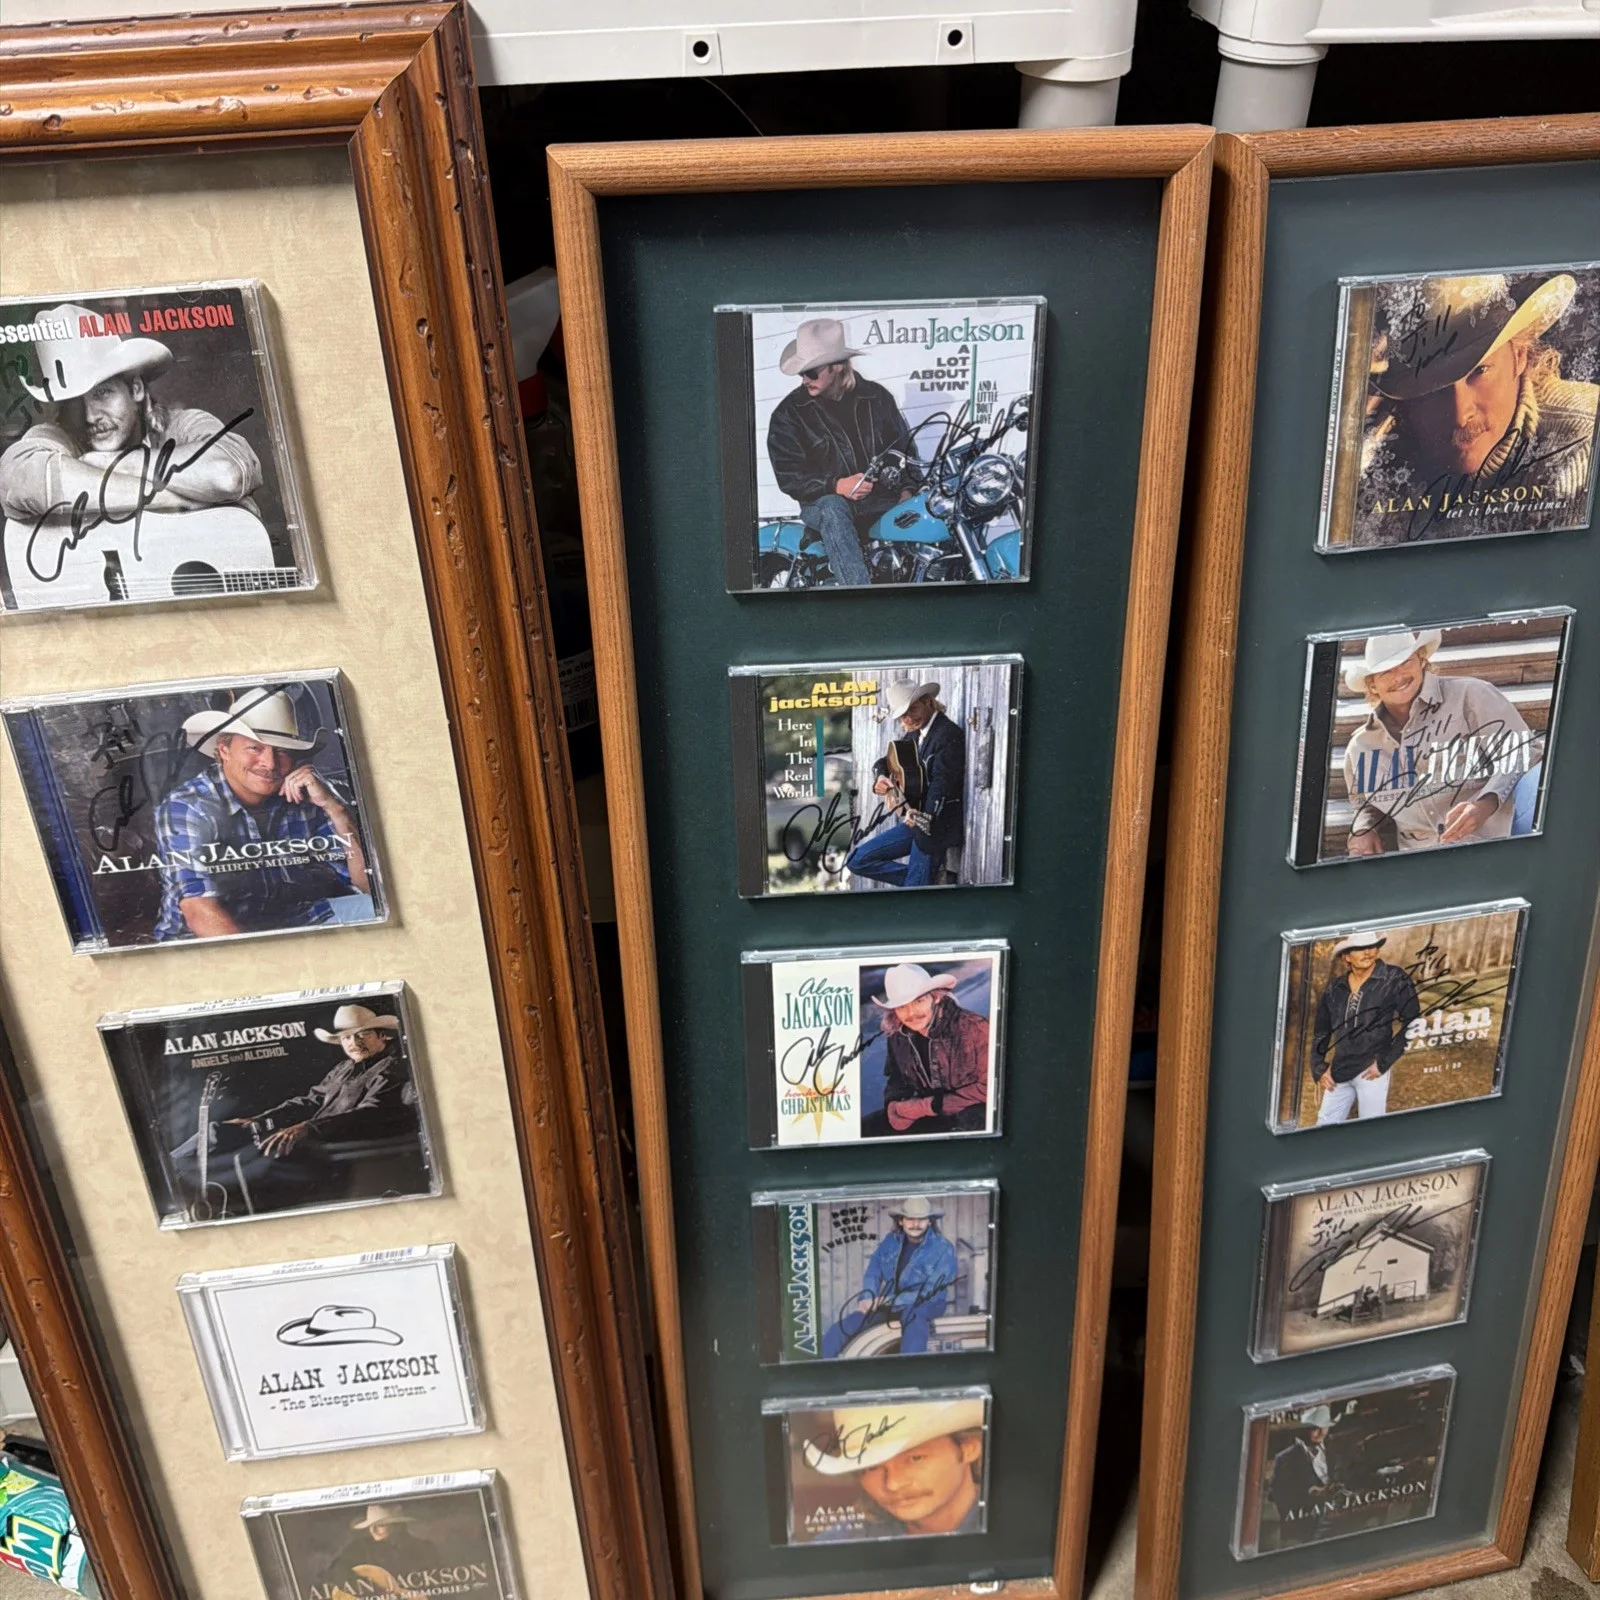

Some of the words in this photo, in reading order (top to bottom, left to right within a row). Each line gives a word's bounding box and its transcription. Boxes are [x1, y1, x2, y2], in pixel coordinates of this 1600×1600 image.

[0, 317, 73, 344] ssential
[78, 312, 132, 338] ALAN
[138, 303, 234, 333] JACKSON
[957, 344, 970, 354] A
[937, 356, 970, 366] LOT
[909, 369, 970, 380] ABOUT
[920, 381, 969, 392] LIVIN'
[977, 391, 998, 402] LITTLE
[1370, 495, 1431, 514] ALAN
[1439, 485, 1545, 512] JACKSON
[1468, 507, 1479, 516] it
[1485, 503, 1499, 515] be
[1503, 499, 1568, 514] Christmas
[811, 680, 877, 694] ALAN
[769, 695, 877, 713] jackson
[778, 719, 813, 731] Here
[800, 735, 816, 747] In
[785, 751, 814, 764] The
[1349, 744, 1416, 797] ALAN
[1419, 729, 1538, 787] JACKSON
[784, 768, 814, 781] Real
[773, 784, 814, 798] World
[92, 850, 195, 875] ALAN
[199, 833, 354, 864] JACKSON
[205, 859, 264, 875] THIRTY
[265, 855, 311, 869] MILES
[314, 850, 356, 863] WEST
[799, 977, 854, 998] Alan
[781, 993, 855, 1030] JACKSON
[1405, 1007, 1492, 1039] alan
[163, 1032, 218, 1055] ALAN
[221, 1021, 307, 1047] JACKSON
[1404, 1029, 1489, 1051] JACKSON
[191, 1054, 230, 1069] ANGELS
[244, 1046, 289, 1061] ALCOHOL
[781, 1094, 851, 1116] CHRISTMAS
[1312, 1189, 1366, 1214] ALAN
[1372, 1171, 1461, 1204] JACKSON
[259, 1368, 325, 1395] ALAN
[337, 1354, 440, 1385] JACKSON
[279, 1399, 306, 1412] The
[309, 1391, 380, 1408] Bluegrass
[383, 1384, 428, 1399] Album
[814, 1505, 855, 1516] ALAN
[1285, 1500, 1336, 1522] ALAN
[1343, 1480, 1428, 1509] JACKSON
[387, 1562, 488, 1592] JACKSON
[400, 1583, 471, 1599] MEMORIES
